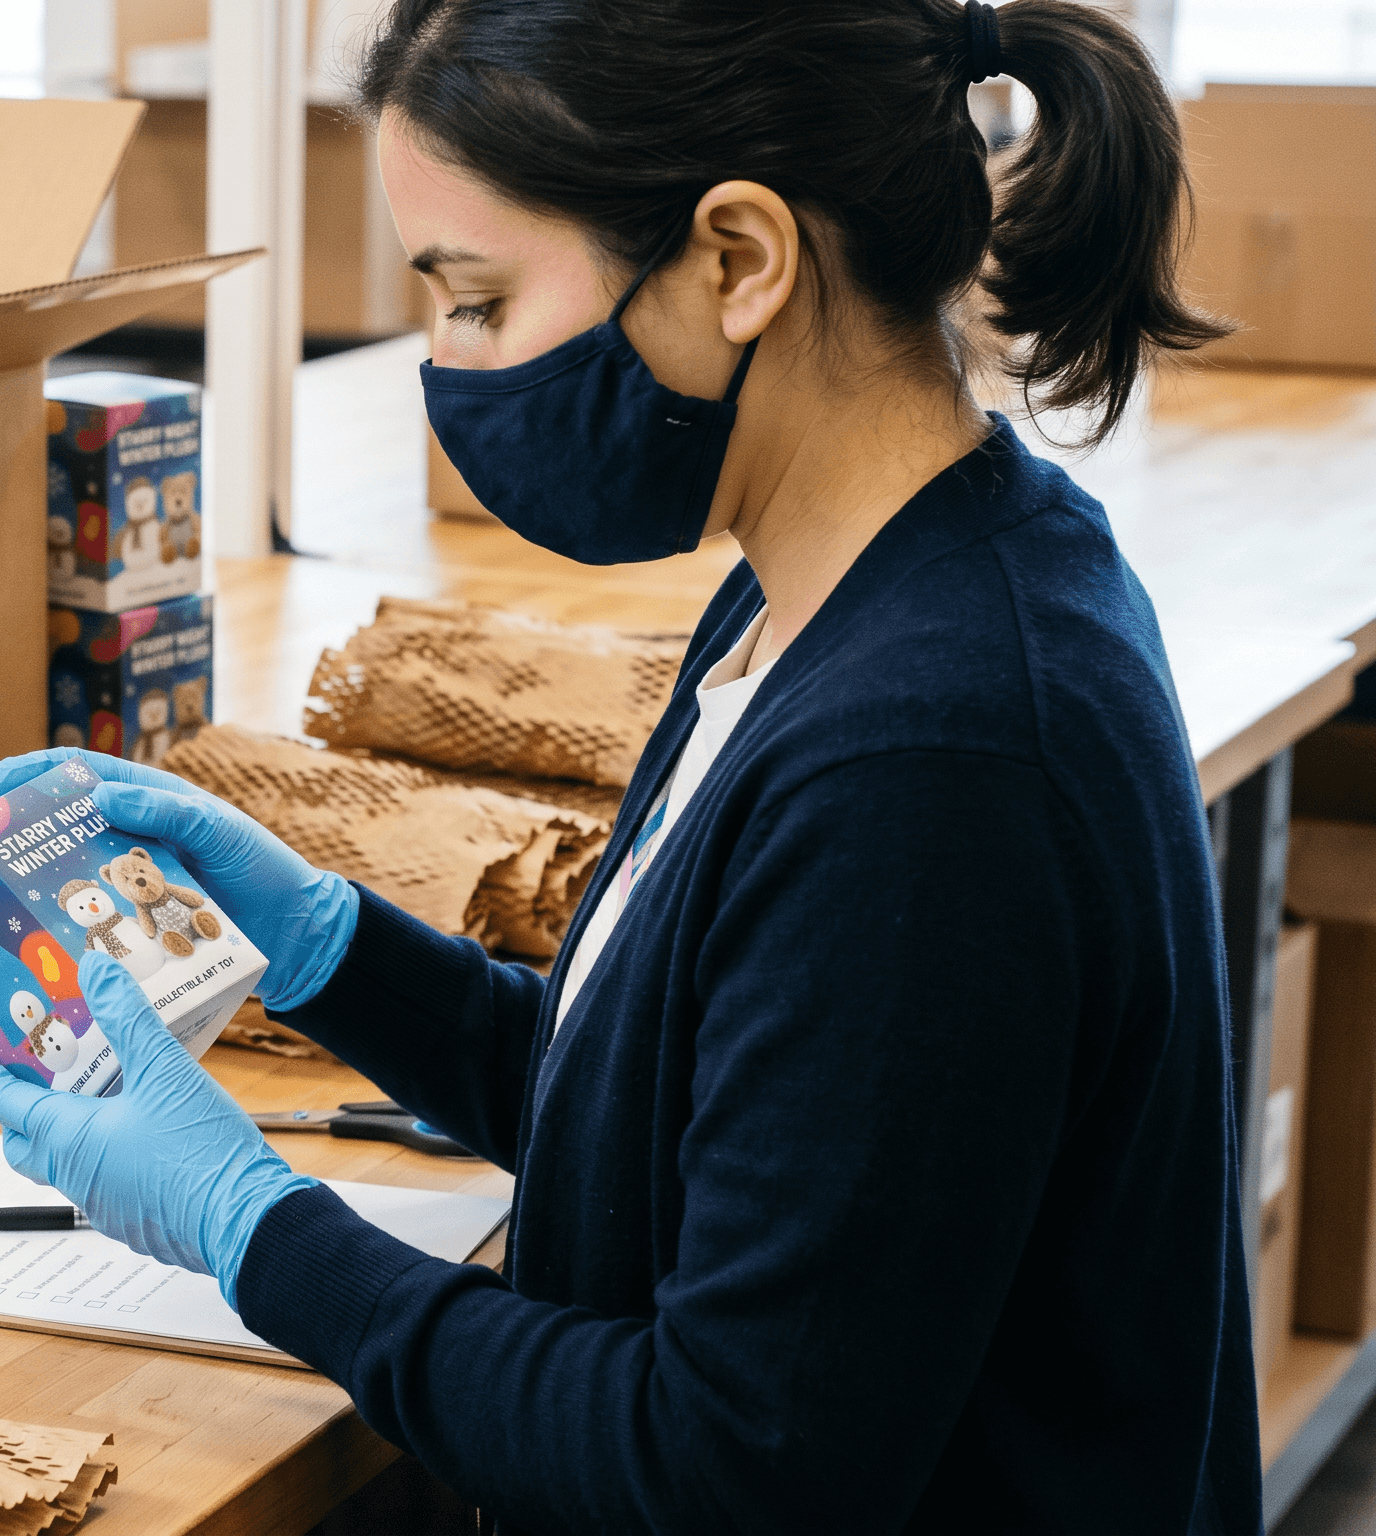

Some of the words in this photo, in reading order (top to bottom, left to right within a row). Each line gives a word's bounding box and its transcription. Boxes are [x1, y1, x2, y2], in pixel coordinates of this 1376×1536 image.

[54, 794, 96, 826] NIGH
[7, 834, 77, 877] WINTER
[70, 814, 110, 843] PLU
[153, 975, 204, 1011] COLLECTIBLE
[202, 965, 219, 981] ART
